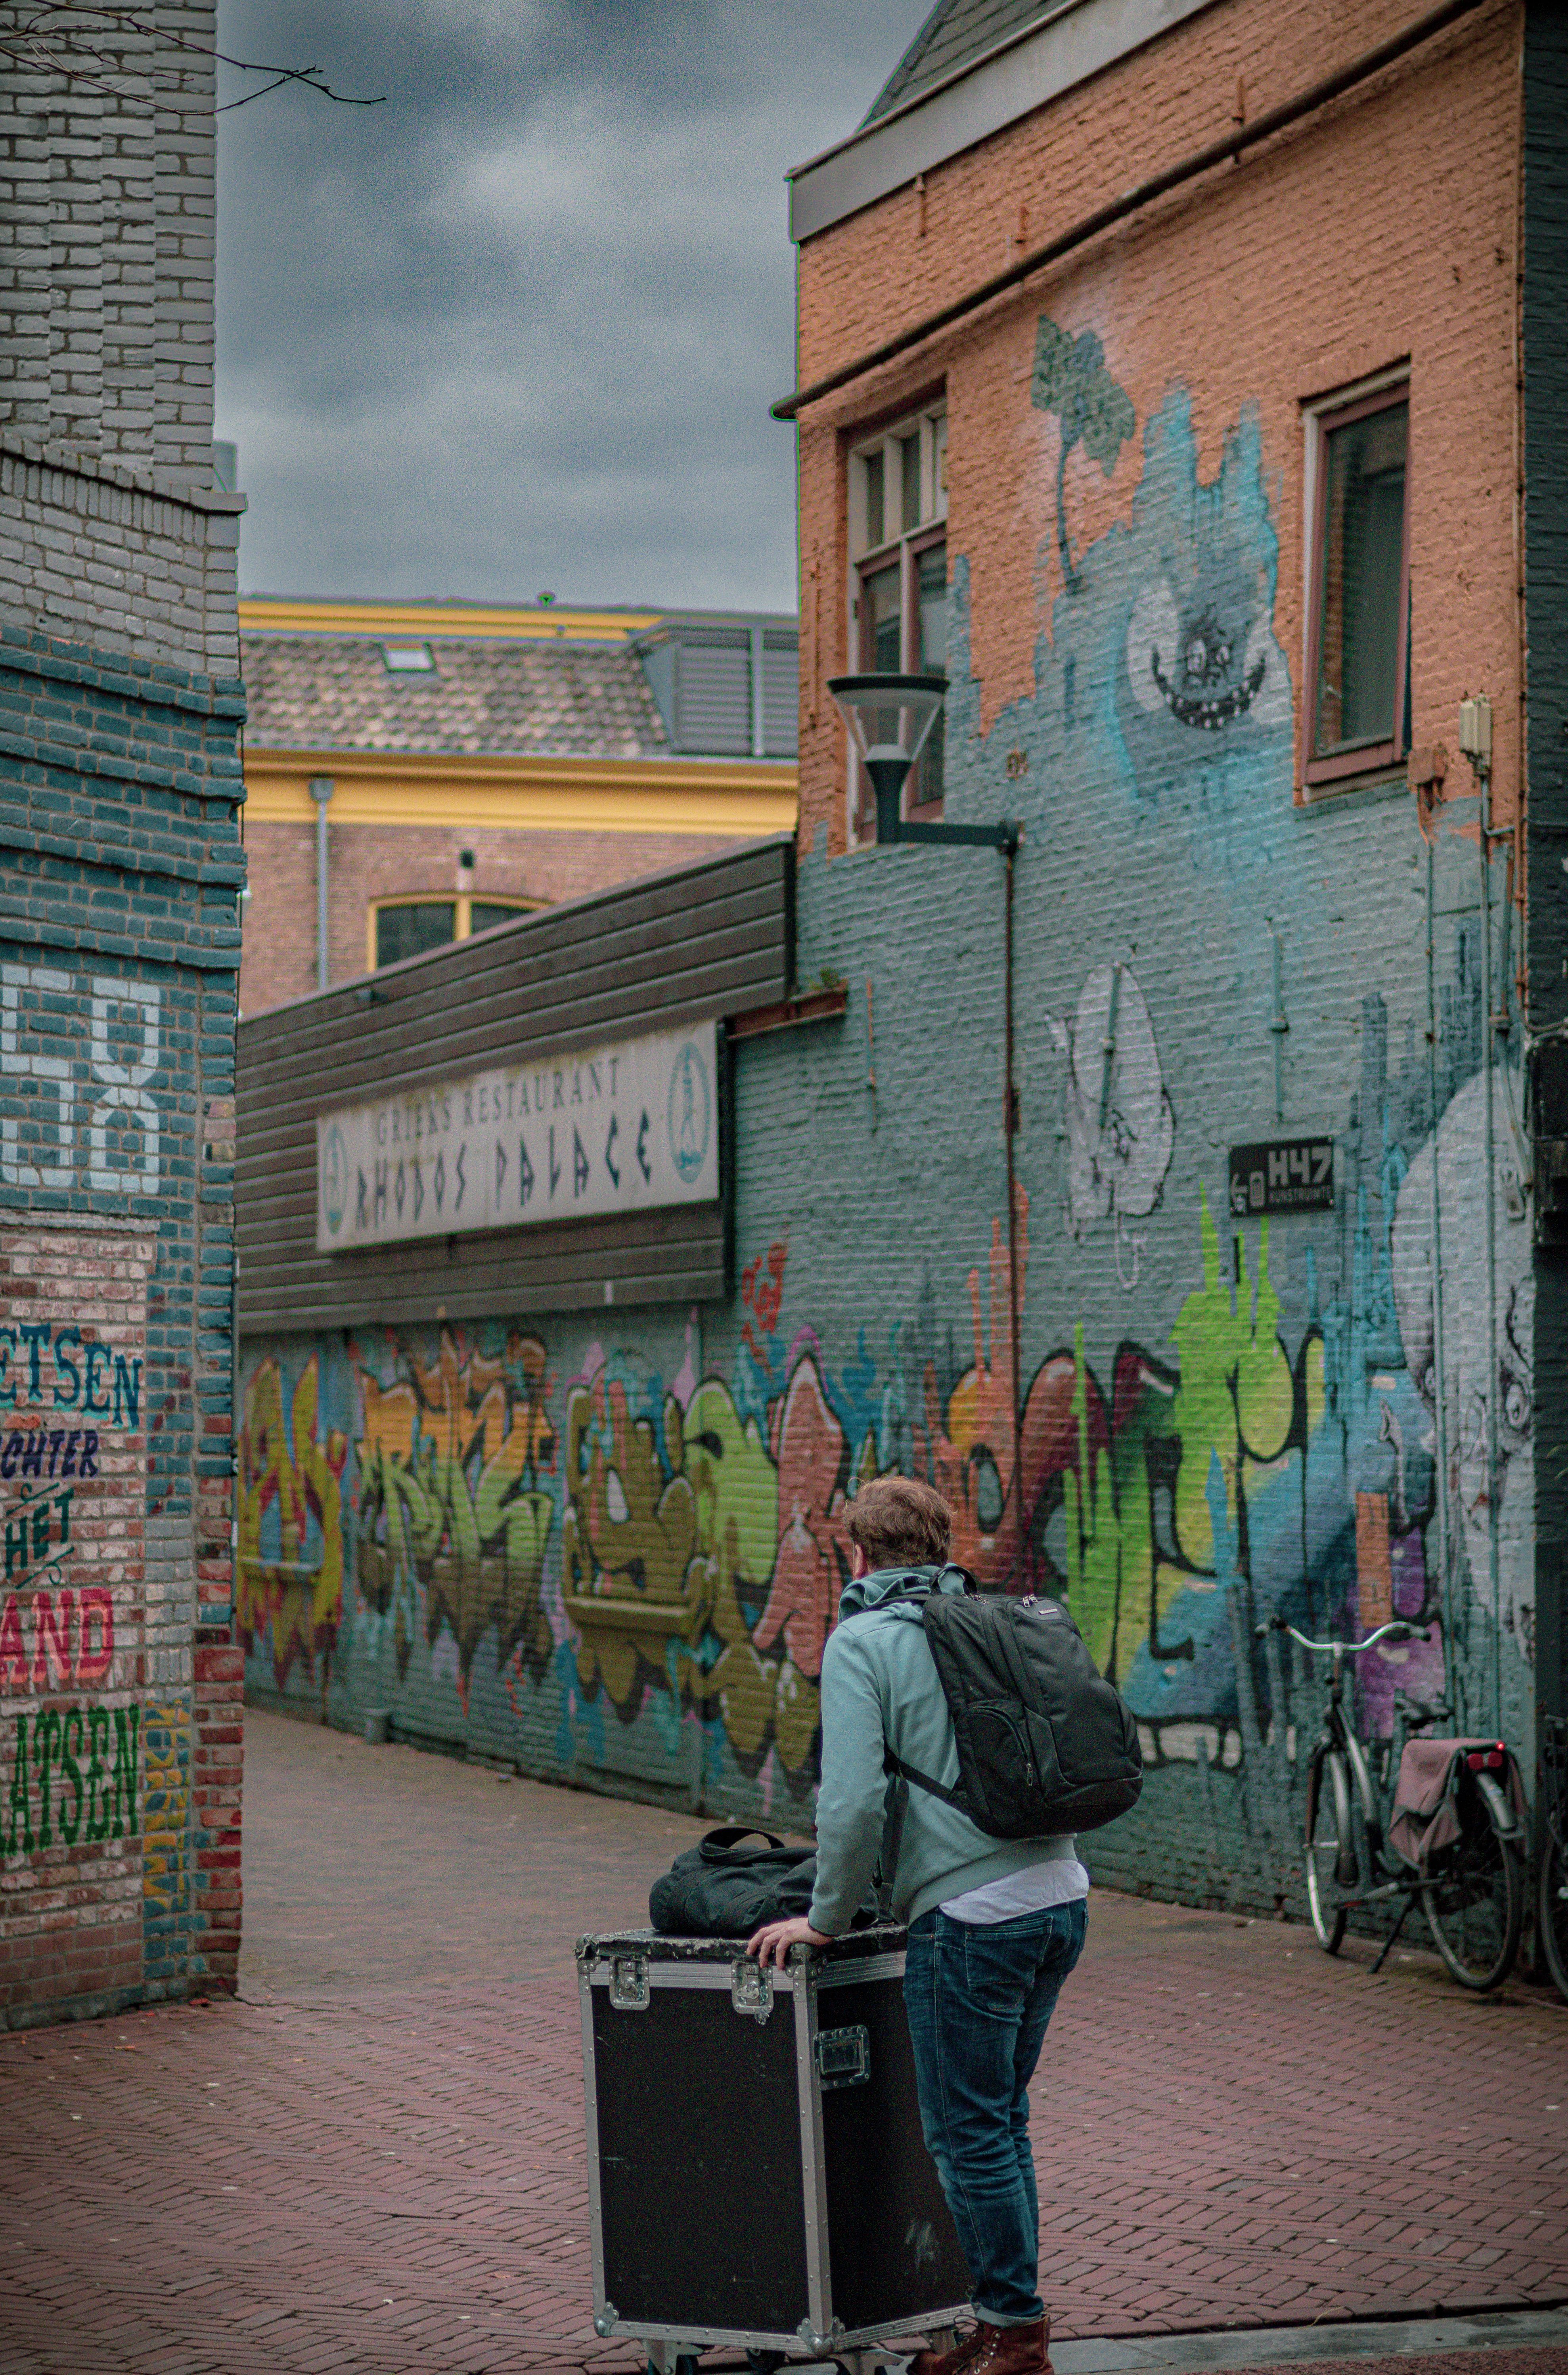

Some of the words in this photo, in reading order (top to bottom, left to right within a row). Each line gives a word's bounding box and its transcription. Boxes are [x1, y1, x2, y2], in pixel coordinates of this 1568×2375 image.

[2, 964, 159, 1194] 58
[377, 1095, 451, 1146] GRIEKS
[463, 1056, 620, 1126] RESTAURANT
[356, 1142, 467, 1230] RHODOS
[495, 1106, 651, 1211] PALACE
[1269, 1145, 1332, 1187] H47
[0, 1429, 98, 1479] CHTER
[5, 1488, 75, 1579] HET
[0, 1703, 141, 1858] ATSEN
